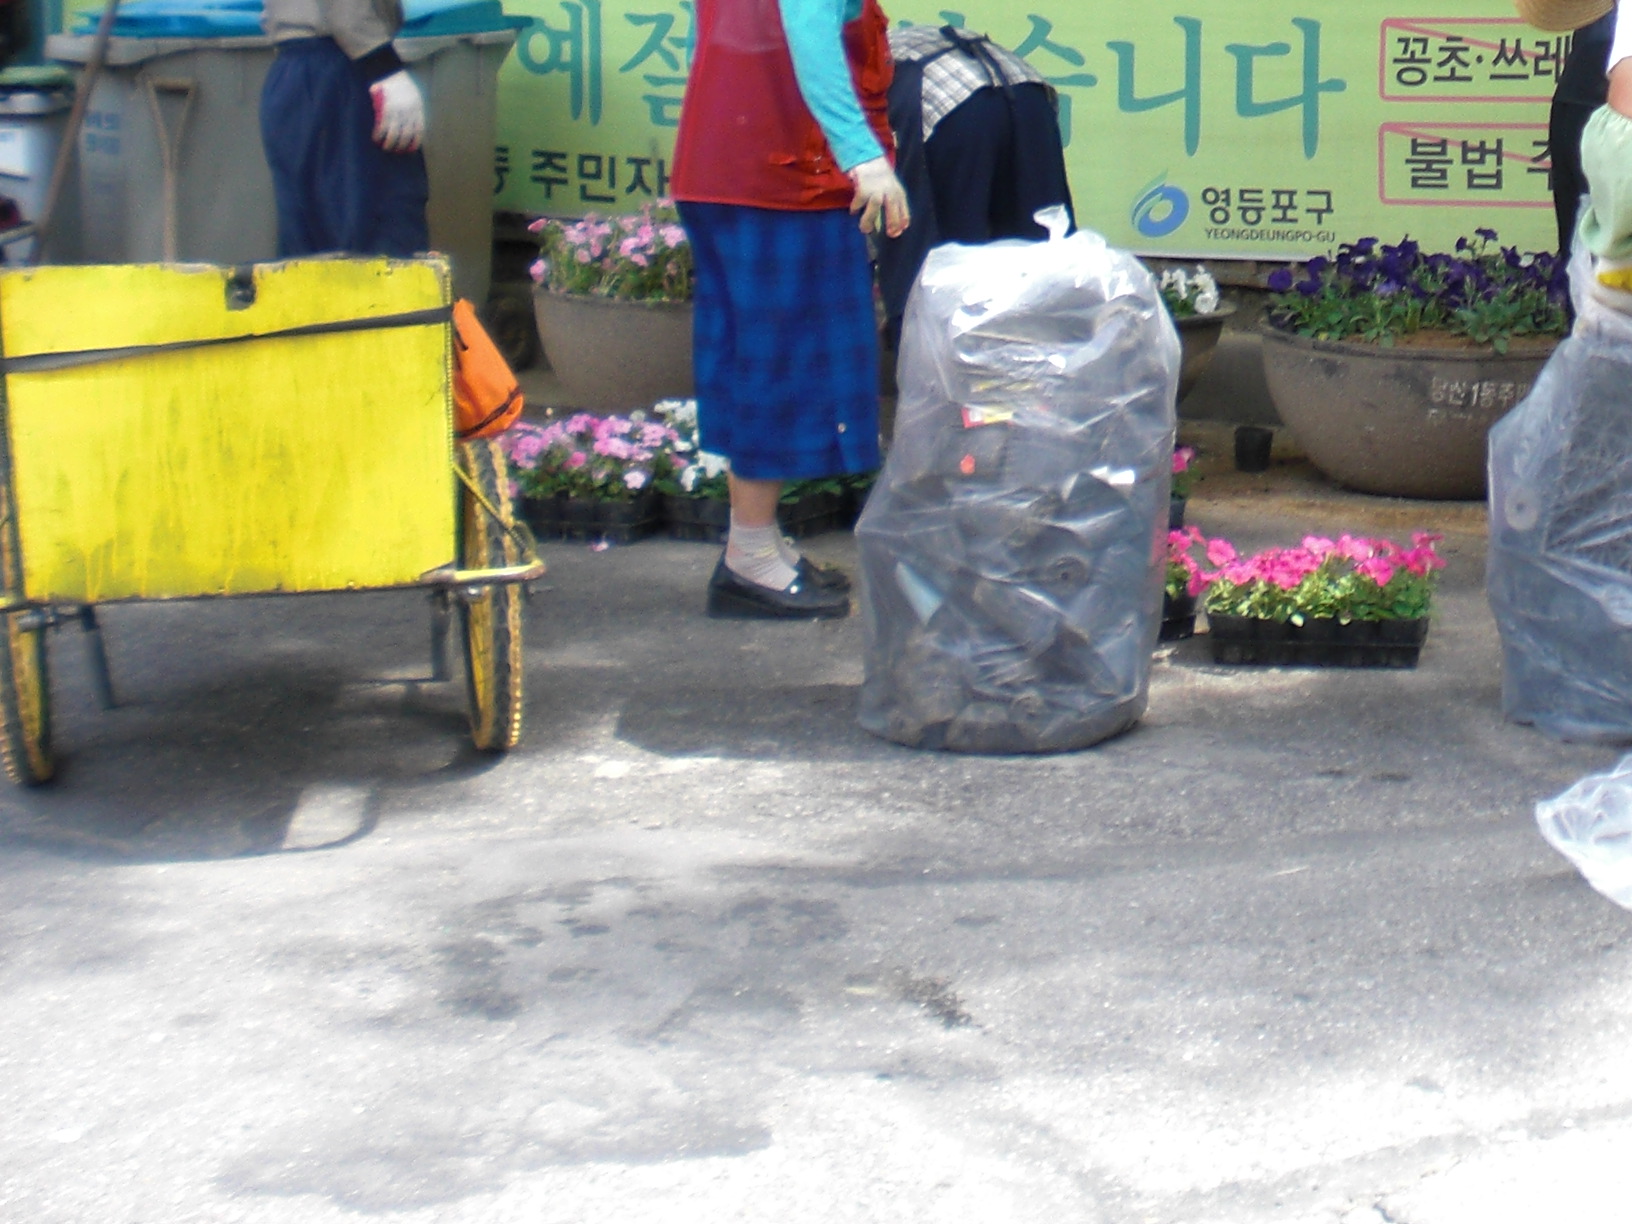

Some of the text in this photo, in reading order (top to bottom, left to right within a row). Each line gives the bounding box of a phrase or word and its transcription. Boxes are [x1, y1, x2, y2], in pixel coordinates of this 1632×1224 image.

[1405, 137, 1503, 190] 불법
[1201, 186, 1334, 226] 영등포구
[1205, 227, 1336, 243] YEONGDEUNGPO-GU
